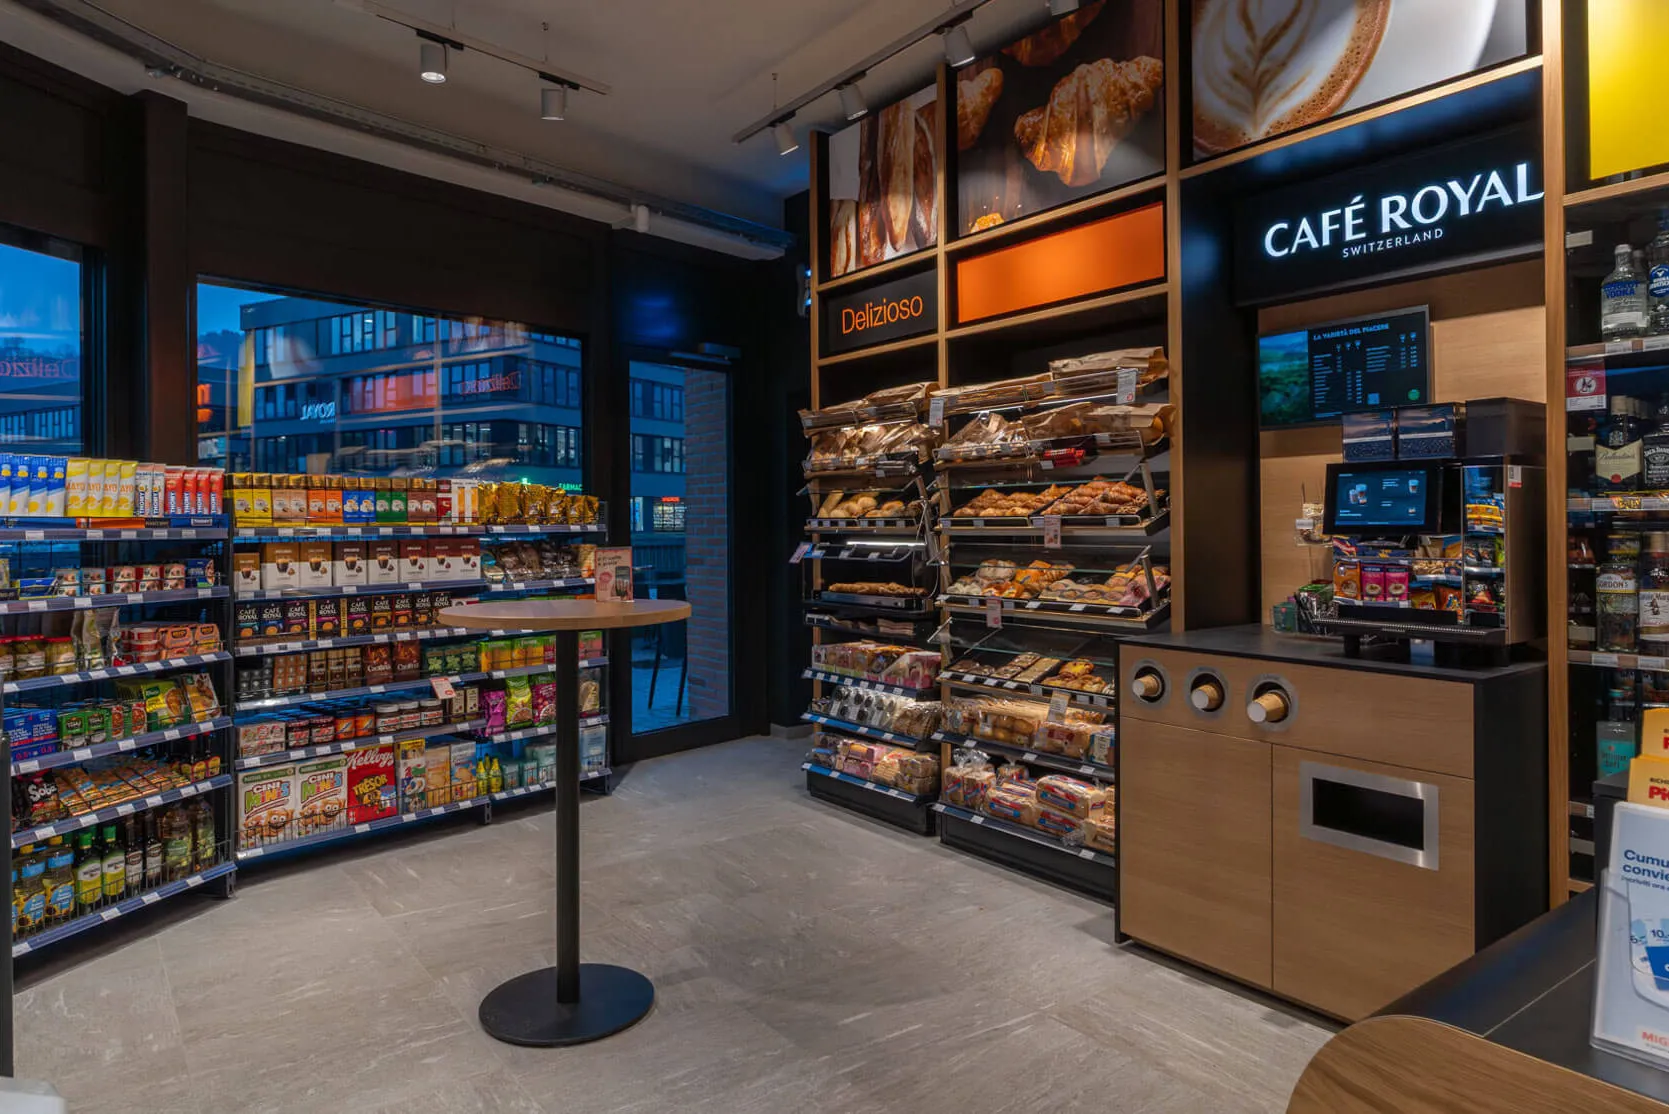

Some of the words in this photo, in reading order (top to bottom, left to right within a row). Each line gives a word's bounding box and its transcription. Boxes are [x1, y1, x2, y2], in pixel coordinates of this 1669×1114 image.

[1264, 194, 1367, 257] CAFÉ
[1381, 163, 1545, 234] ROYAL
[1342, 228, 1443, 258] SWITZERLAND
[842, 296, 923, 335] Delizioso
[253, 781, 281, 793] CINI
[308, 772, 335, 784] CINI
[28, 783, 57, 801] Soba
